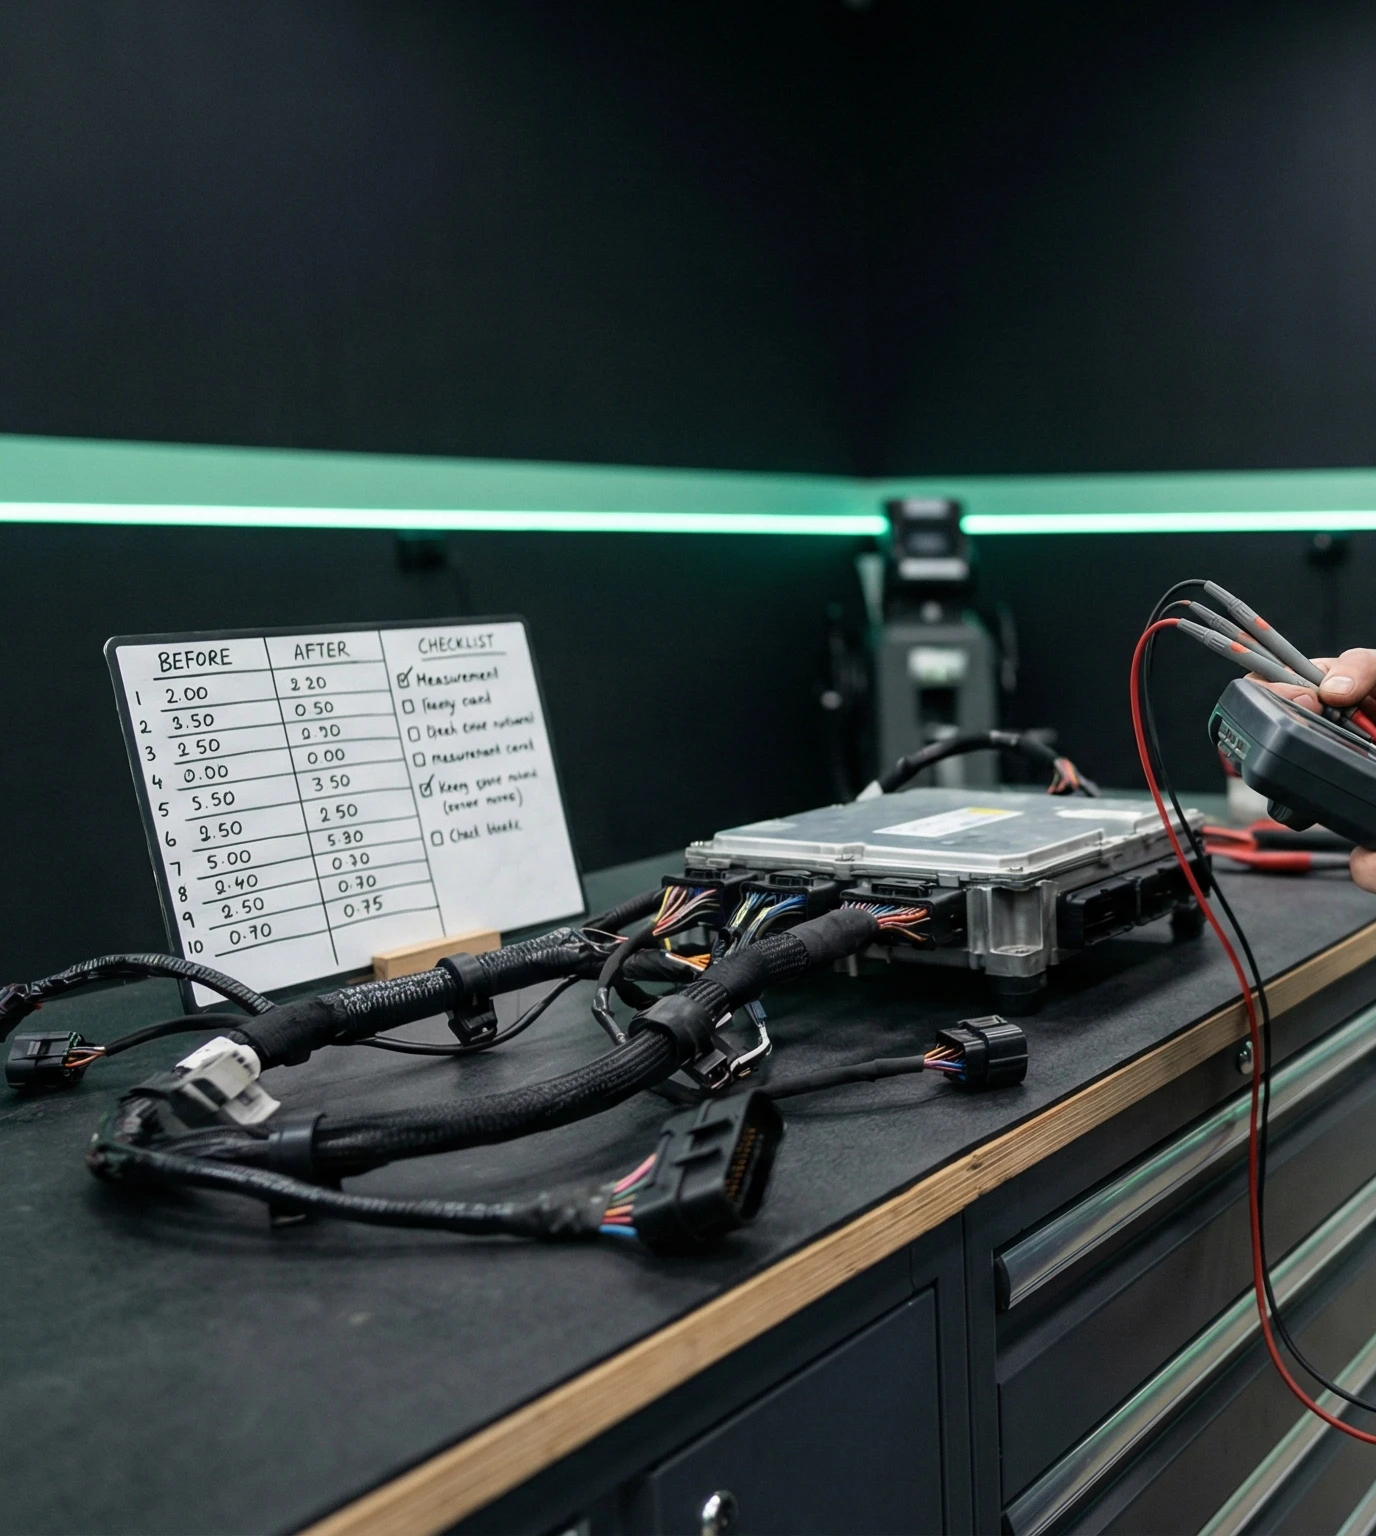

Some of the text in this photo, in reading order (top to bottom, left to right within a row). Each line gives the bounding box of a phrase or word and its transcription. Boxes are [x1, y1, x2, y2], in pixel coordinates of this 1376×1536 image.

[295, 641, 350, 660] AFTER
[418, 633, 495, 654] CHECKLIST
[158, 648, 233, 673] BEFORE
[135, 691, 141, 705] 1
[166, 687, 208, 704] 2.00
[140, 720, 152, 734] 2
[172, 713, 214, 730] 3.50
[145, 746, 156, 761] 3
[152, 774, 162, 789] 4
[183, 765, 229, 783] 0.00
[158, 802, 169, 817] 5
[192, 791, 235, 811] 5.50
[165, 831, 176, 847] 6
[200, 821, 242, 842] 2.50
[206, 849, 252, 870] 5.00
[169, 861, 181, 876] 7
[178, 886, 188, 902] 8
[220, 897, 265, 920] 2.50
[343, 895, 383, 918] 0.75
[182, 911, 195, 928] 9
[229, 922, 272, 945] 0.70
[188, 940, 203, 954] 10
